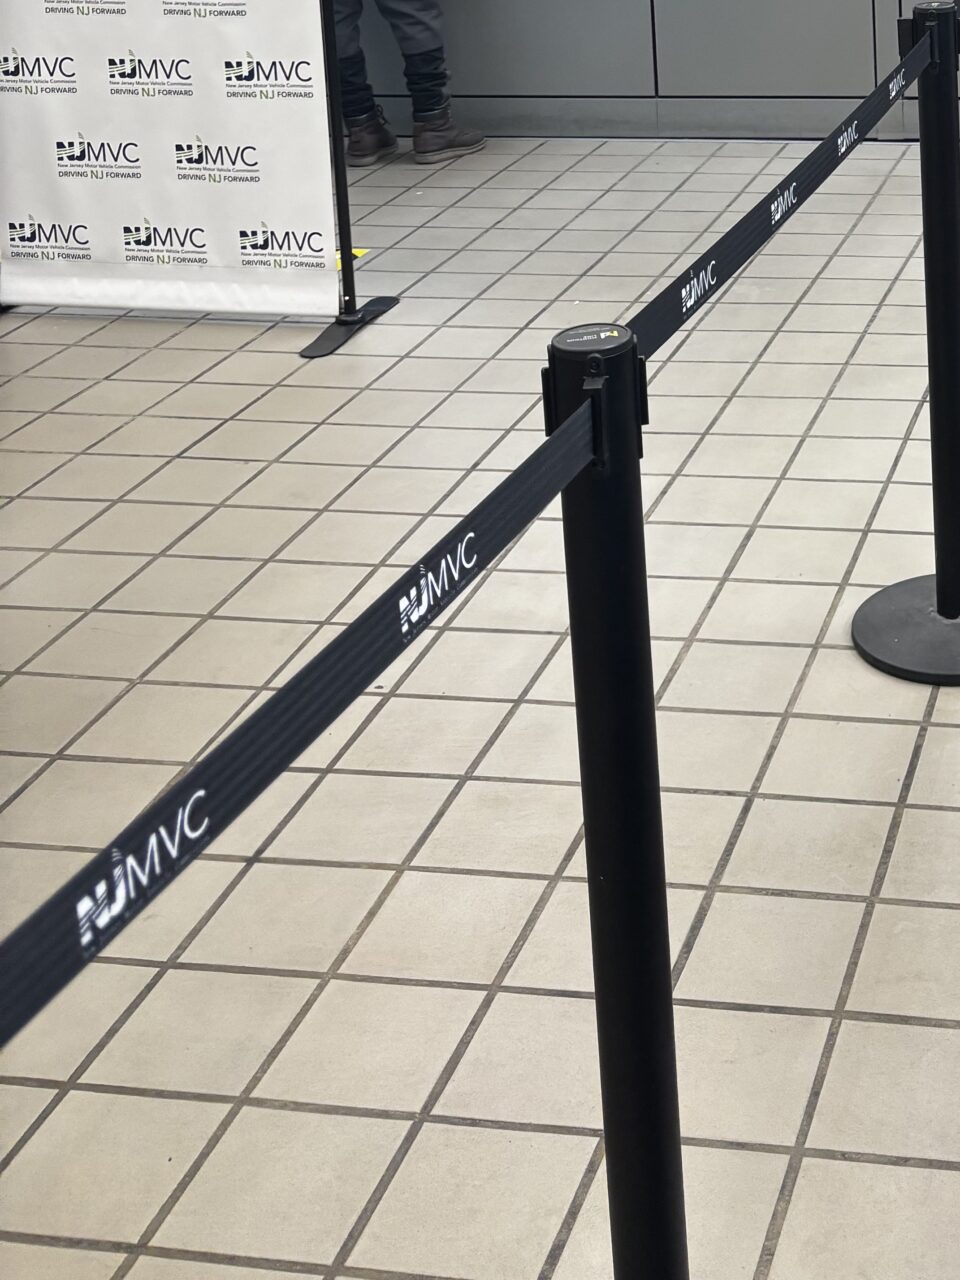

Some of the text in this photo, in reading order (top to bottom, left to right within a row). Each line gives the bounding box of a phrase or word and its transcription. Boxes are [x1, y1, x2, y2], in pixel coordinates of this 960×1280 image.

[76, 6, 90, 16] NJ
[193, 8, 207, 18] NJ
[108, 58, 192, 80] NJMVC
[224, 60, 312, 82] NJMVC
[25, 85, 38, 95] NJ
[141, 88, 156, 97] NJ
[259, 90, 275, 100] NJ
[56, 142, 139, 163] NJMVC
[176, 144, 258, 166] NJMVC
[90, 170, 104, 180] NJ
[208, 173, 222, 183] NJ
[9, 222, 88, 245] NJMVC
[123, 226, 206, 248] NJMVC
[240, 230, 323, 252] NJMVC
[11, 251, 92, 261] DRIVING NJ FORWARD
[156, 255, 171, 266] NJ
[242, 260, 272, 268] DRIVING
[273, 259, 288, 270] NJ
[681, 260, 717, 312] NJMVC
[399, 532, 477, 633] NJMVC
[77, 789, 208, 946] NJMVC
